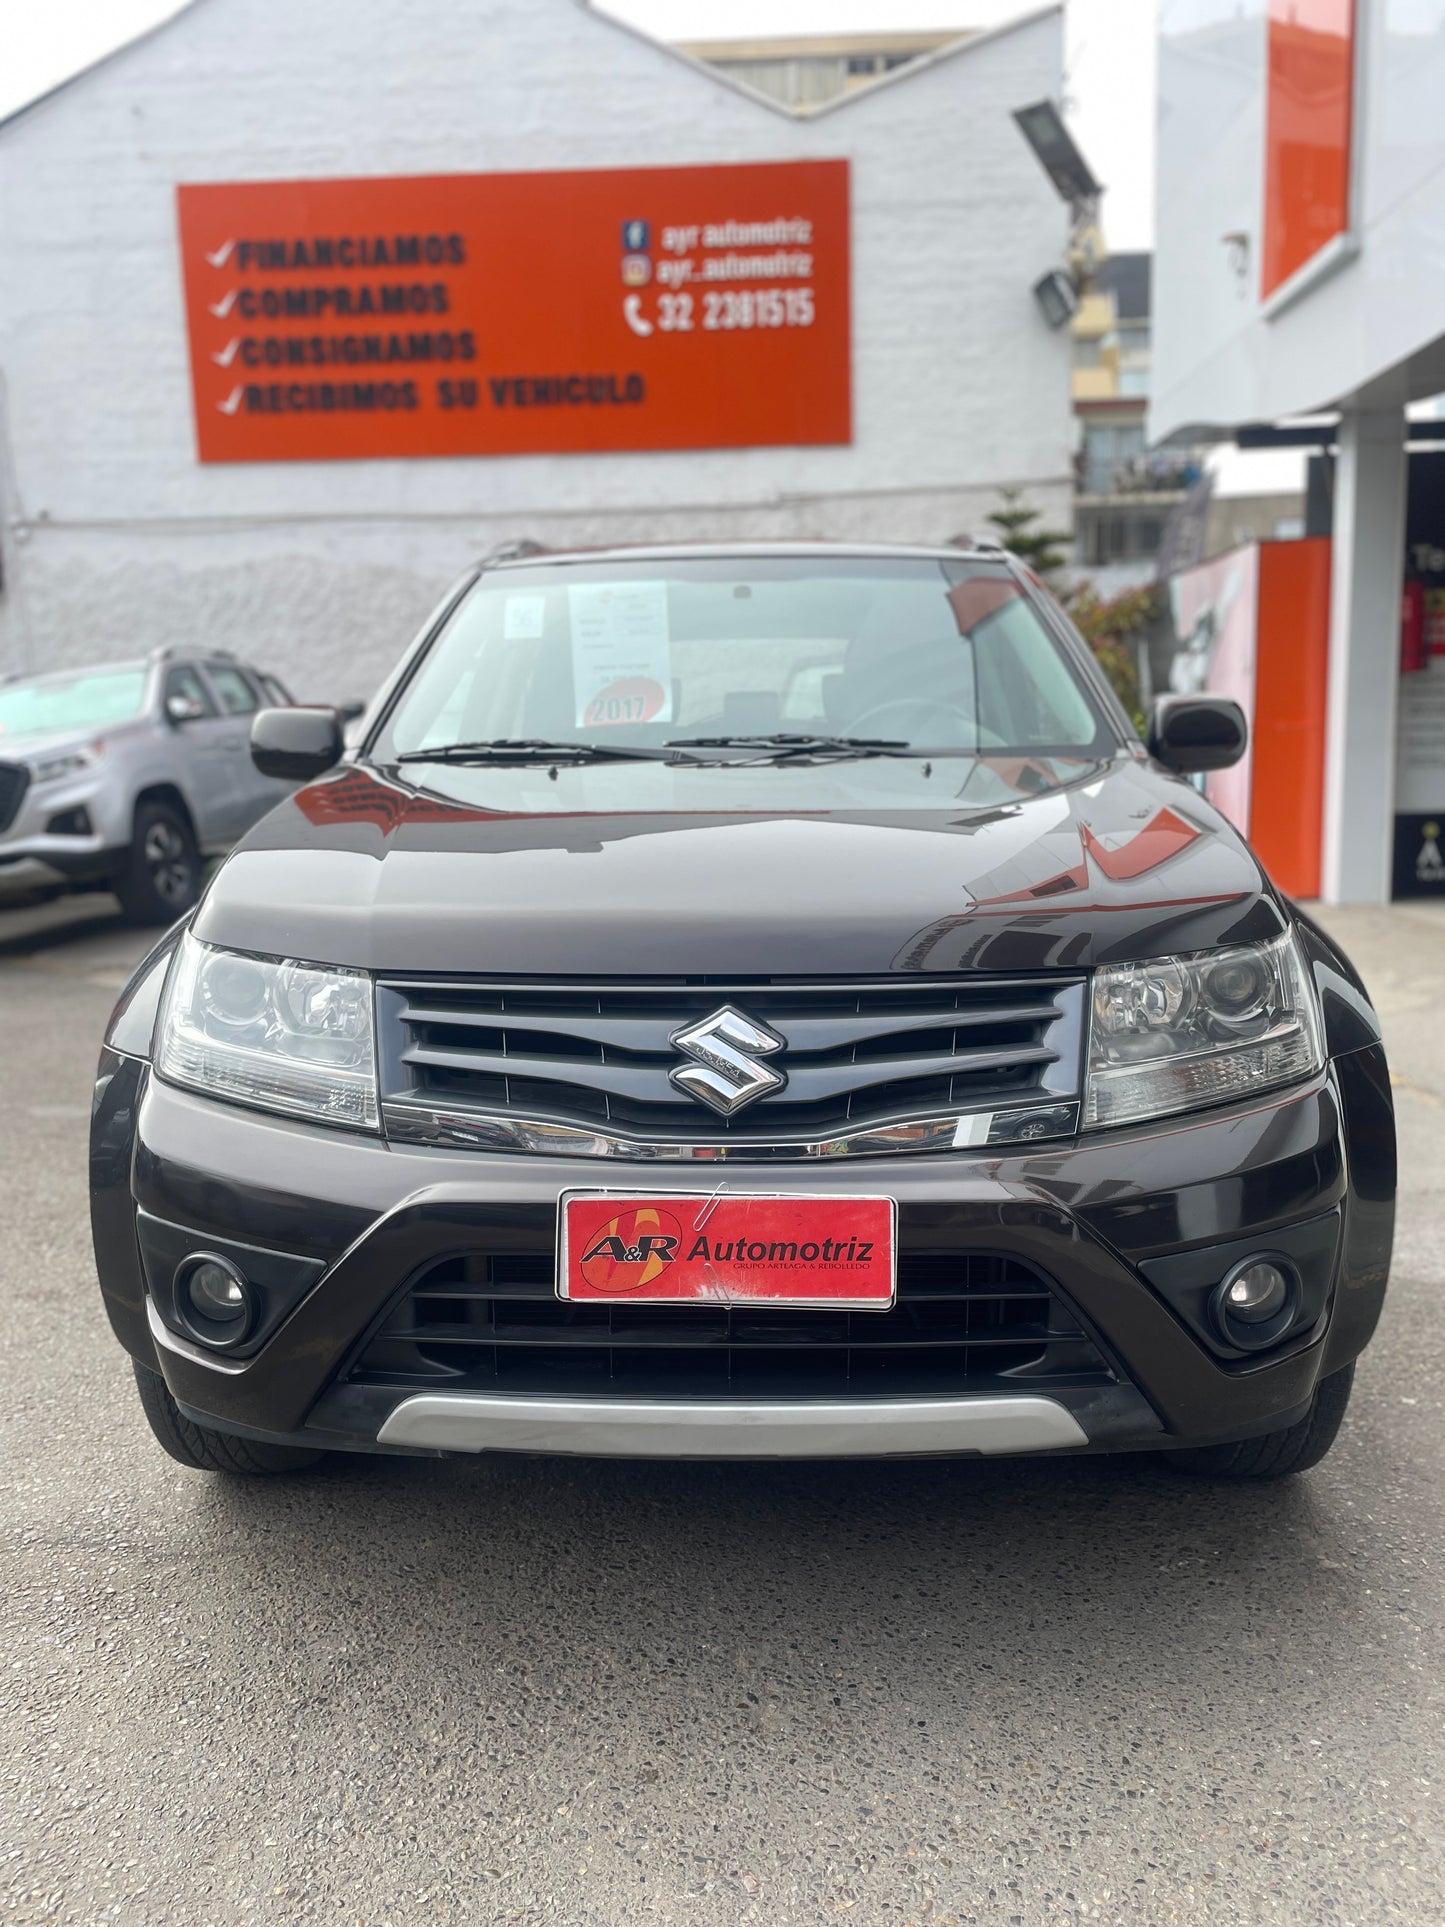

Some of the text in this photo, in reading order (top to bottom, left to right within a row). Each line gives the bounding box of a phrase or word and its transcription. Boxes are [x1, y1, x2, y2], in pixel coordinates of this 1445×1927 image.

[702, 217, 812, 248] automotriz
[237, 233, 466, 271] FINANCIAMOS
[238, 283, 449, 318] COMPRAMOS
[657, 292, 694, 331] 32
[240, 331, 476, 367] CONSIGNAMOS
[245, 372, 646, 413] RECIBIMOS SU VEHICULO
[592, 696, 645, 722] 2017
[579, 1235, 874, 1263] A&R Automotriz
[733, 1262, 766, 1270] GRUPO
[767, 1262, 807, 1270] ARTEAGA
[818, 1262, 871, 1270] REBOLLEDO
